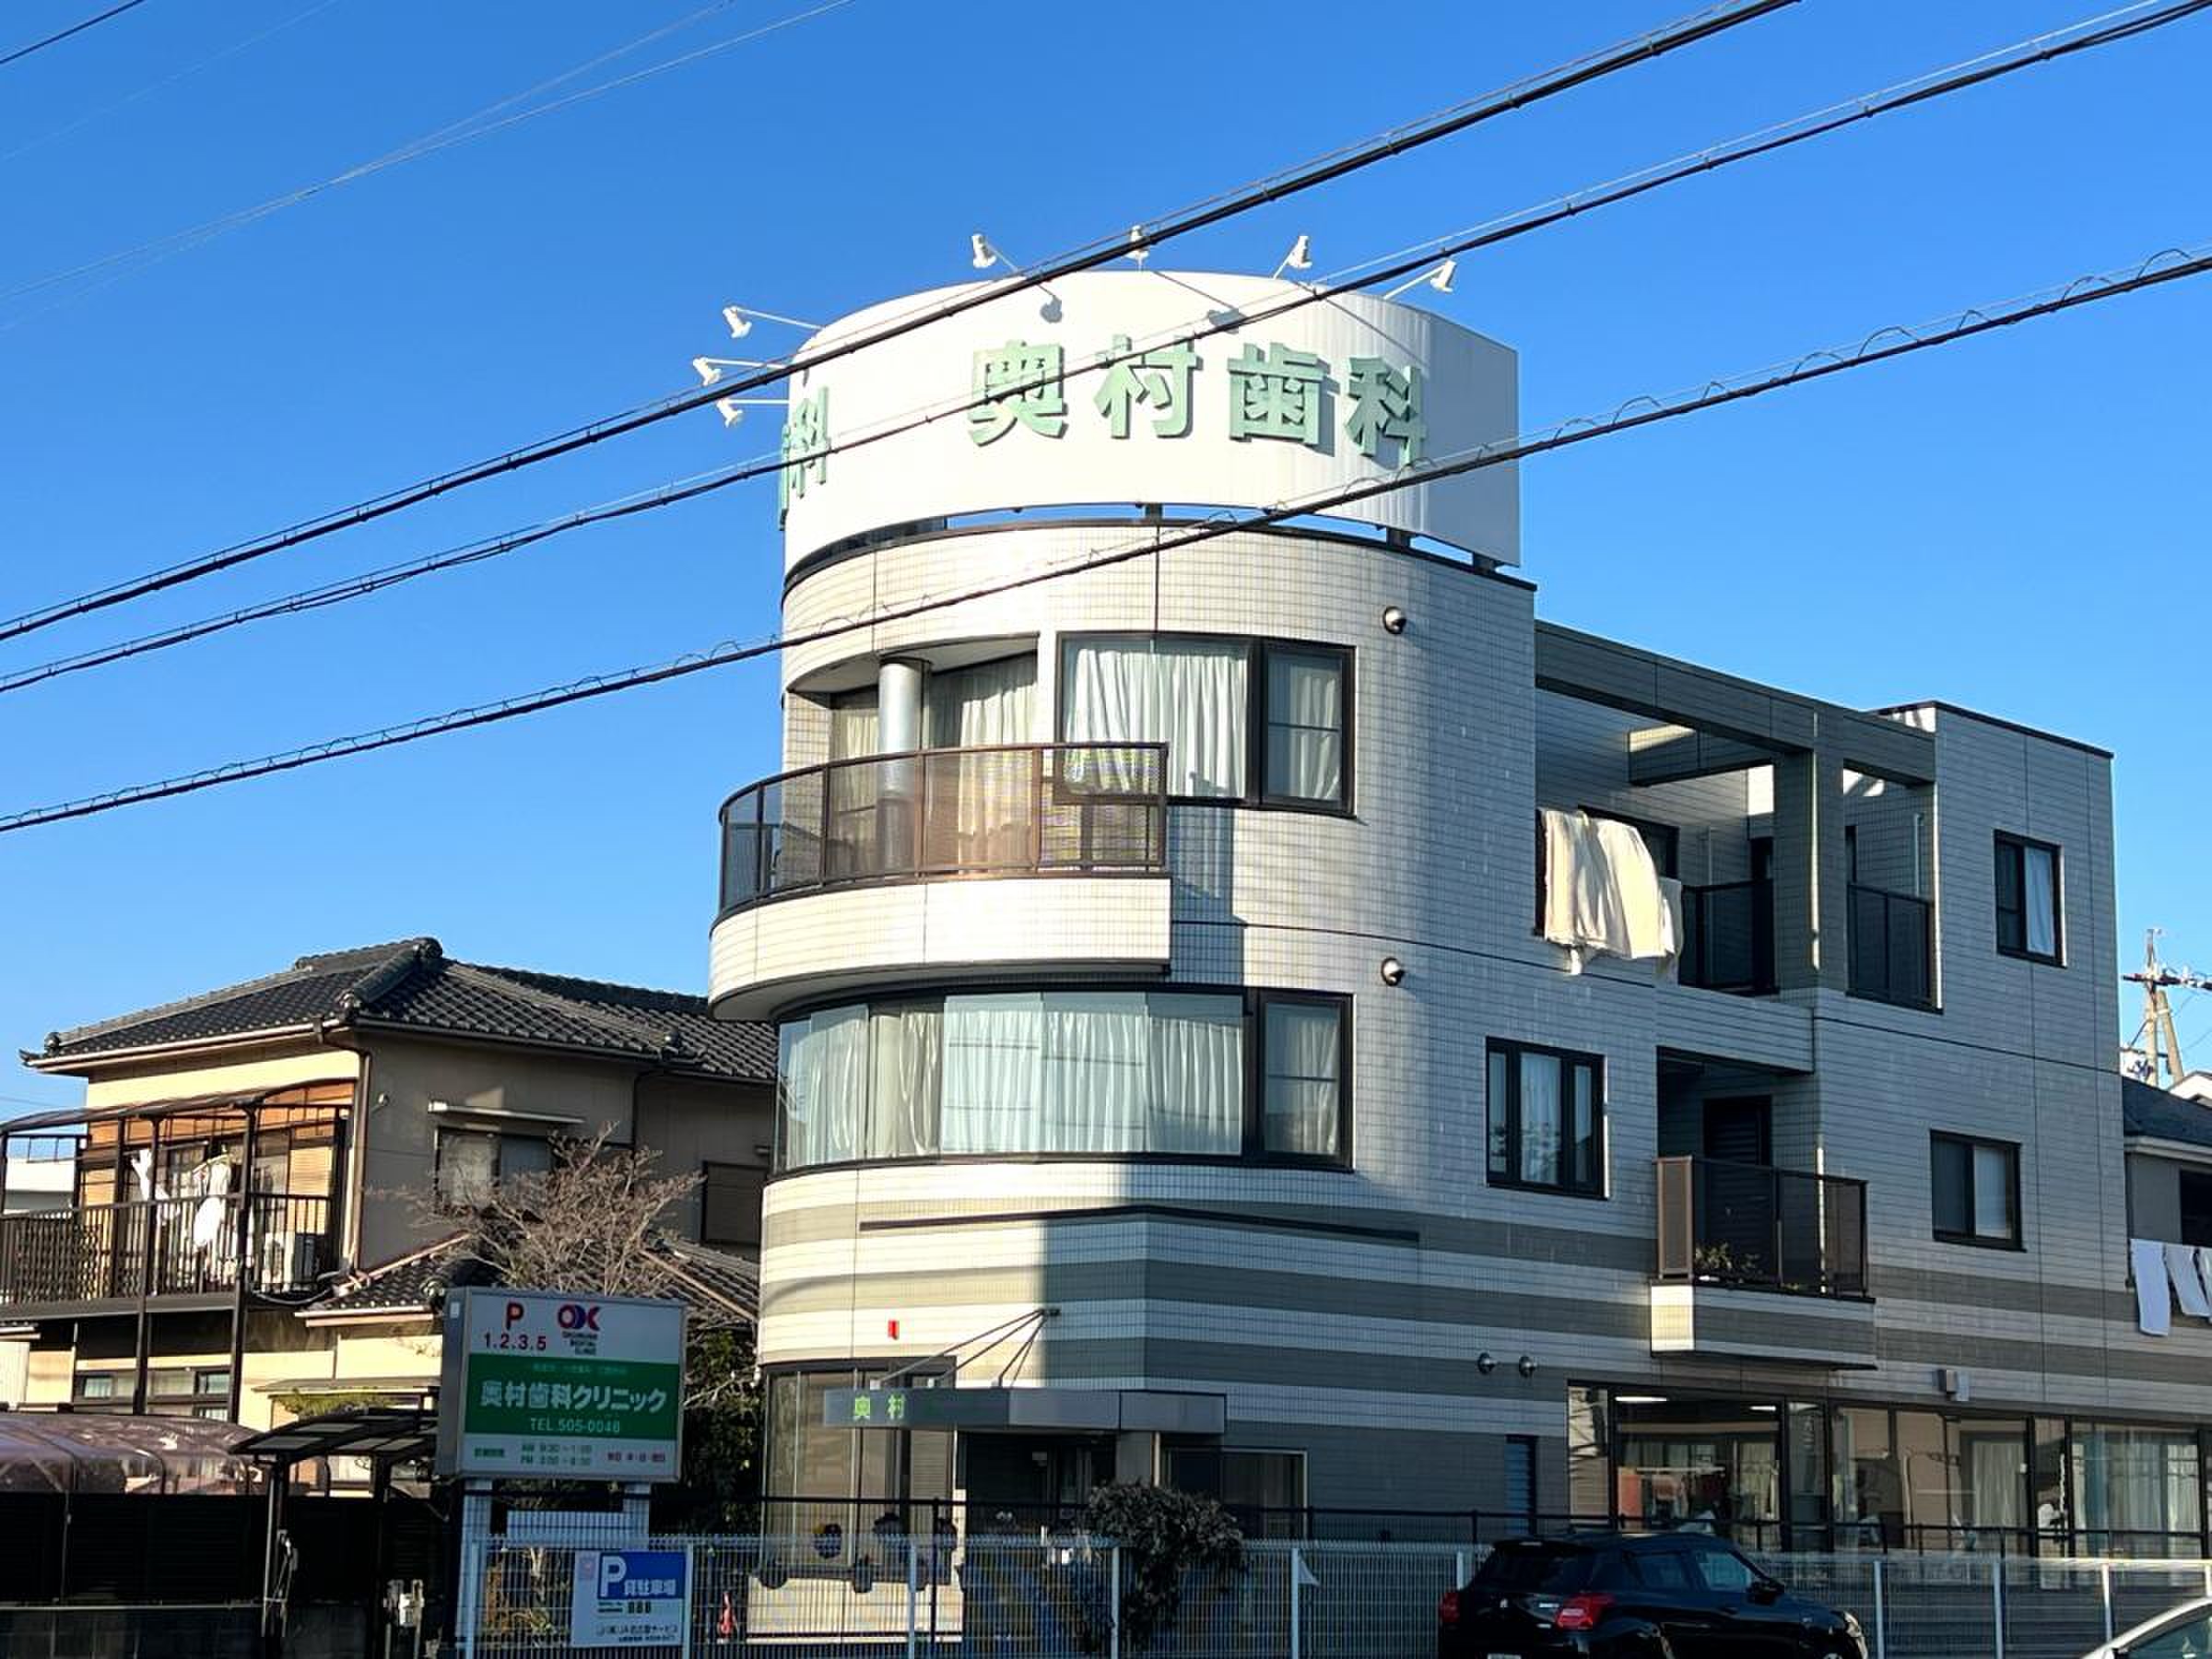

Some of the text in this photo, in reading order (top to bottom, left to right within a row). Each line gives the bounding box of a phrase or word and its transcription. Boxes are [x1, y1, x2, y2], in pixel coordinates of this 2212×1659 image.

[967, 335, 1428, 465] 奥村歯科
[506, 1301, 524, 1330] P
[480, 1380, 667, 1413] 奥村歯科クリニック
[600, 1555, 627, 1597] P
